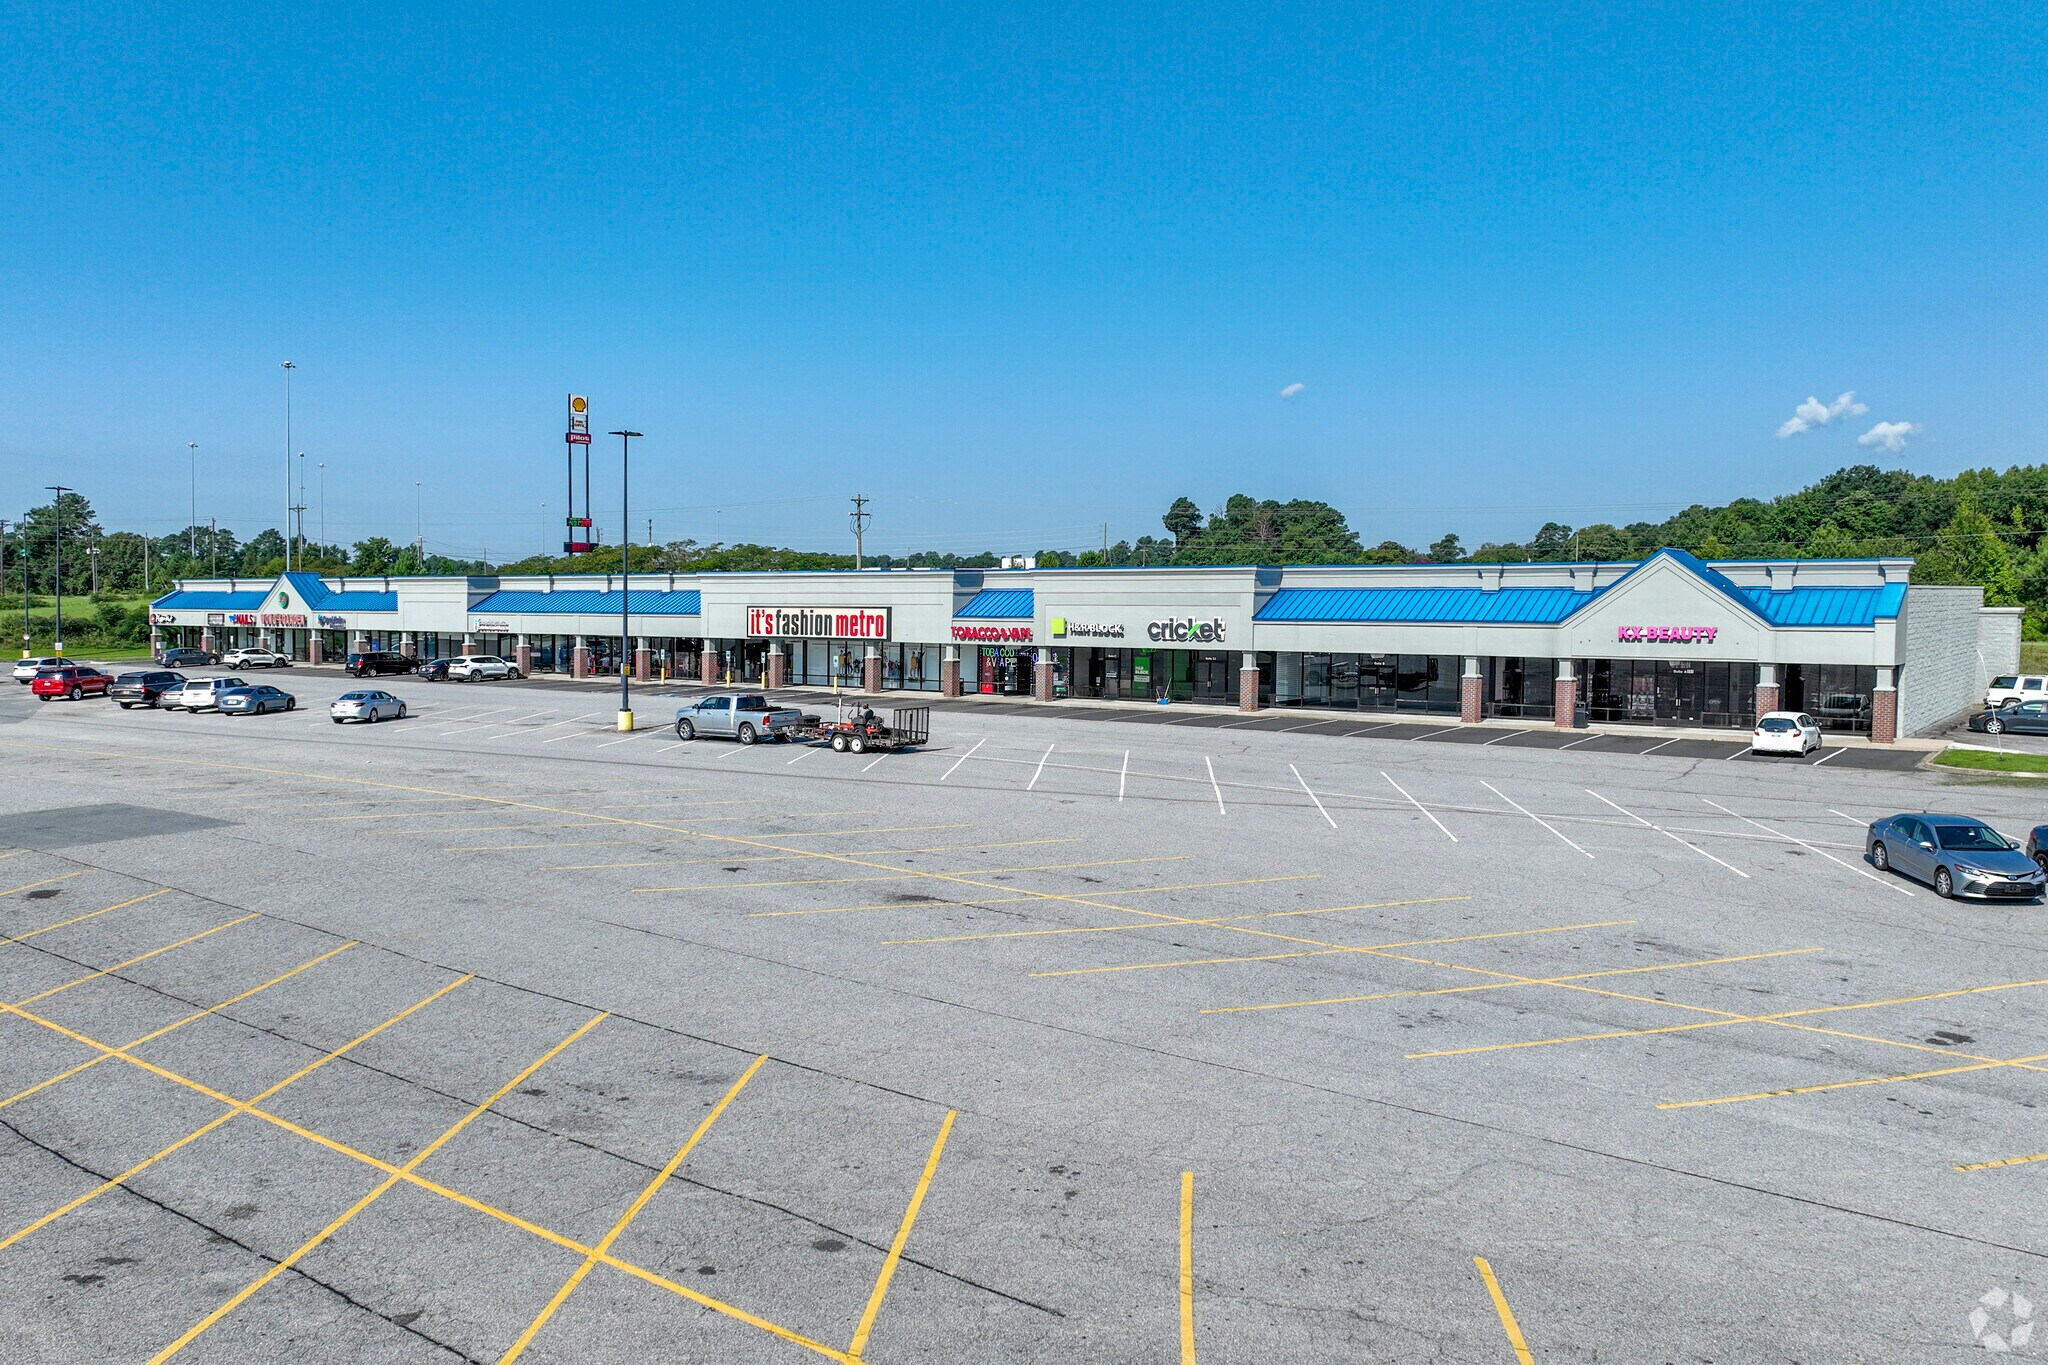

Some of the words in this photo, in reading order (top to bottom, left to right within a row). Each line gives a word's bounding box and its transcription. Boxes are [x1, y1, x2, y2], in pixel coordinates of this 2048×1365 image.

[750, 609, 773, 635] it's
[775, 609, 833, 636] fashion
[835, 610, 885, 637] metro
[1068, 622, 1089, 632] H&R
[1089, 623, 1122, 633] BLOCK
[1147, 617, 1225, 640] cricket
[951, 626, 1000, 640] TOBACCO
[1008, 627, 1031, 640] VAPE
[1618, 626, 1643, 639] KX
[1646, 626, 1718, 640] BEAUTY
[982, 648, 1015, 657] TOBACCO
